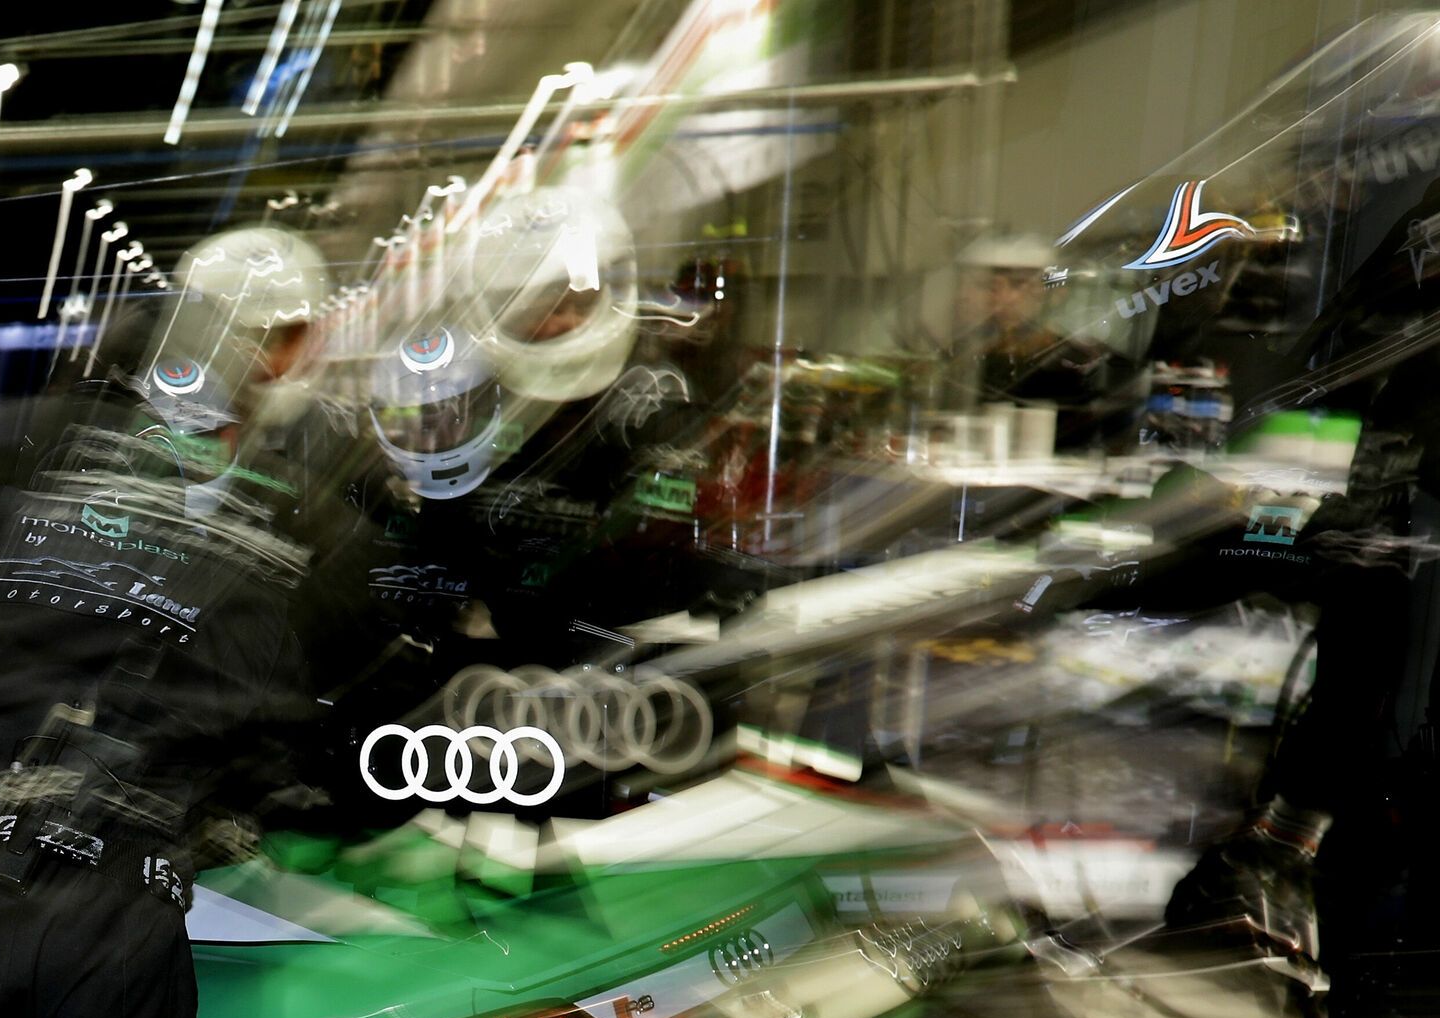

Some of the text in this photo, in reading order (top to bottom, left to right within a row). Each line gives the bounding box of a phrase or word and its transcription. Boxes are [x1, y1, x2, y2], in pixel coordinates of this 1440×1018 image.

[1115, 260, 1220, 319] uvex
[21, 515, 190, 565] montaplast
[25, 532, 48, 547] by
[1219, 547, 1312, 565] montaplast
[125, 582, 201, 623] Land
